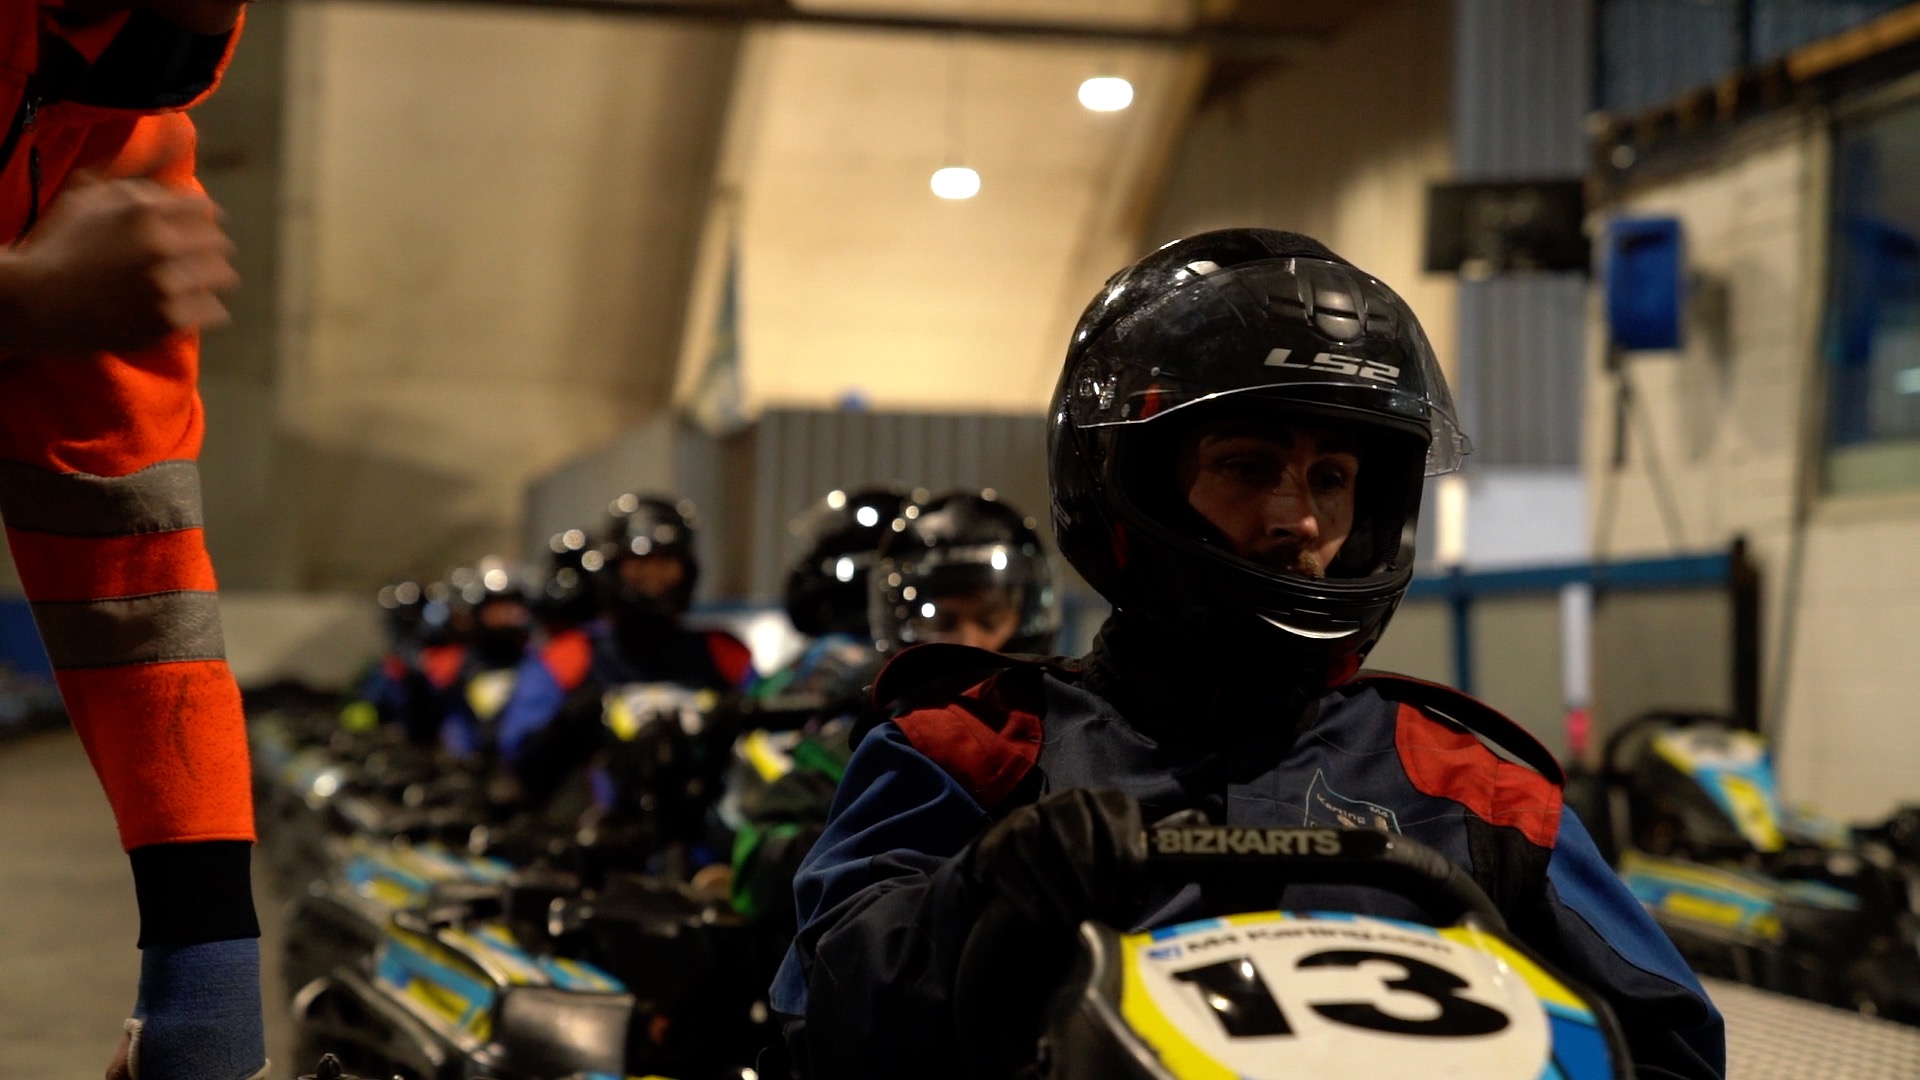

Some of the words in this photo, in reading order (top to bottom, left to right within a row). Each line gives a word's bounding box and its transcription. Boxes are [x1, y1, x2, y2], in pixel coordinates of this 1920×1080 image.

[1263, 347, 1401, 386] LS2
[1156, 827, 1341, 856] BIZKARTS
[1171, 949, 1511, 1040] 13
